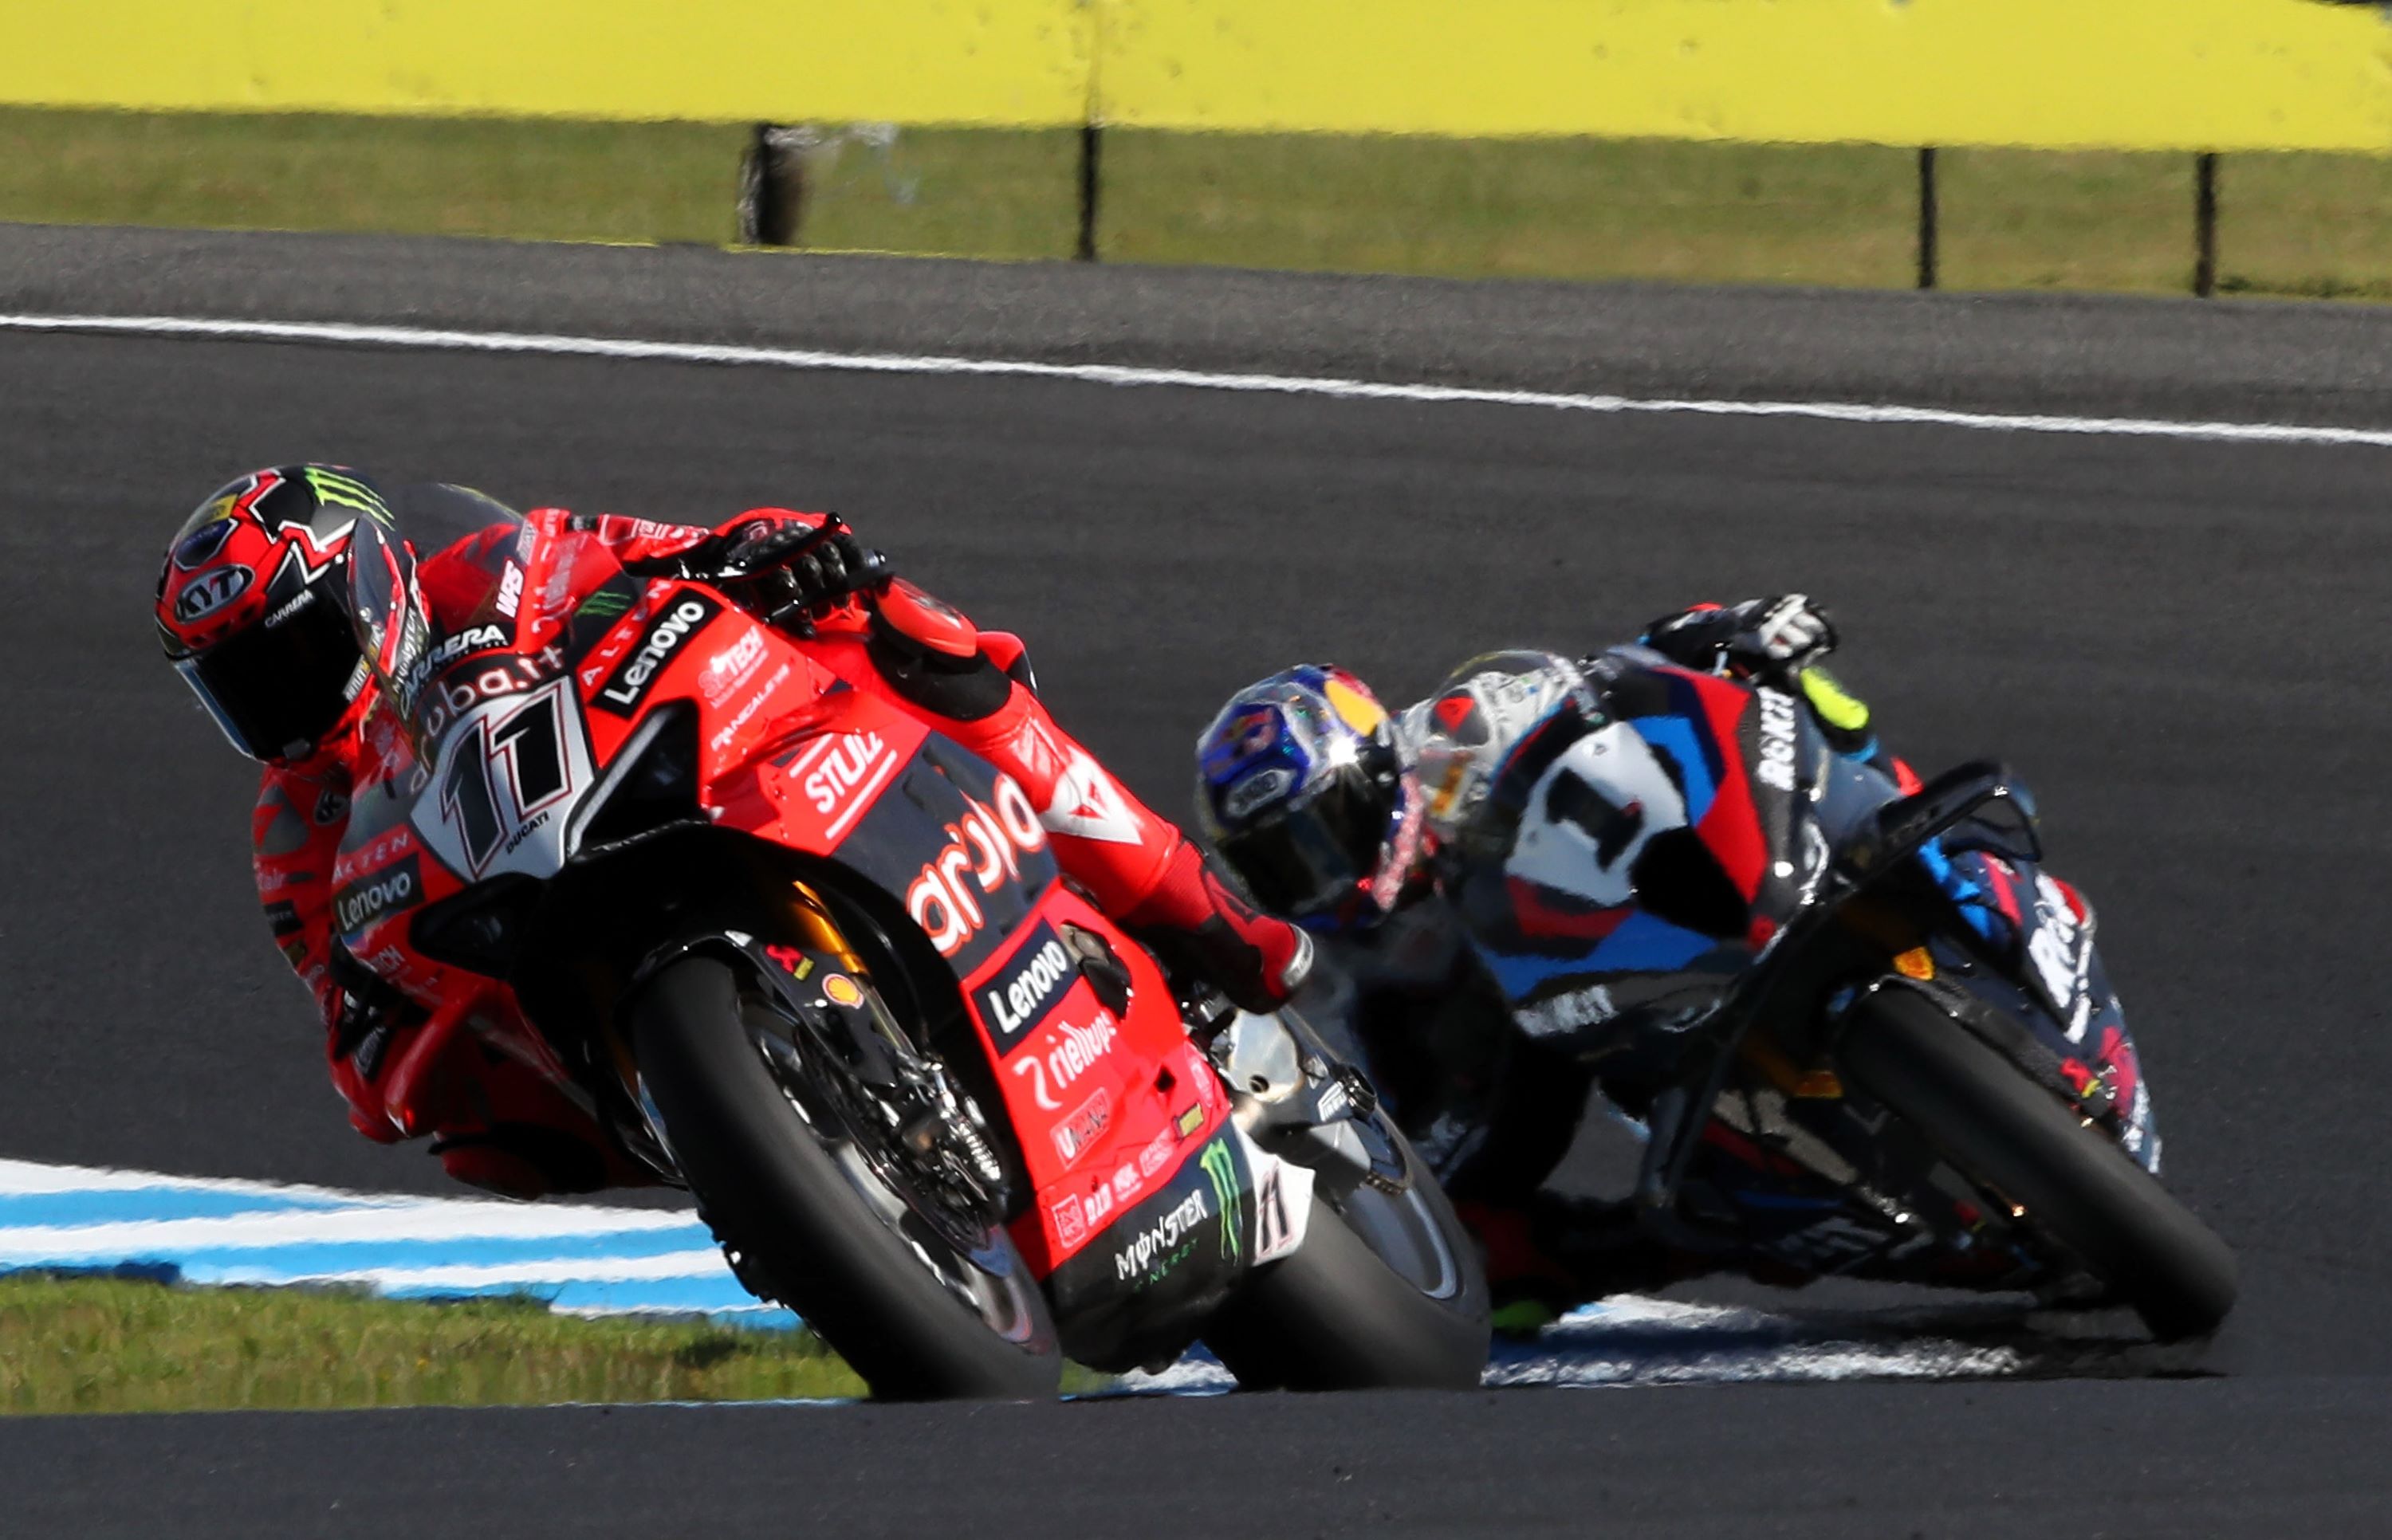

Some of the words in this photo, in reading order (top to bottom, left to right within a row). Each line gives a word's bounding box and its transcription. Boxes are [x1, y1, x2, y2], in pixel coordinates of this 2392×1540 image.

[176, 568, 238, 621] KYT
[265, 589, 313, 628] CARRERA
[496, 560, 524, 619] WRS
[604, 601, 705, 705] Lenovo
[441, 675, 571, 879] 11
[506, 811, 548, 854] DUCATI
[1545, 766, 1643, 874] 1
[338, 872, 411, 931] Lenovo
[988, 940, 1068, 1034] Lenovo
[1115, 1188, 1207, 1280] MONSTER
